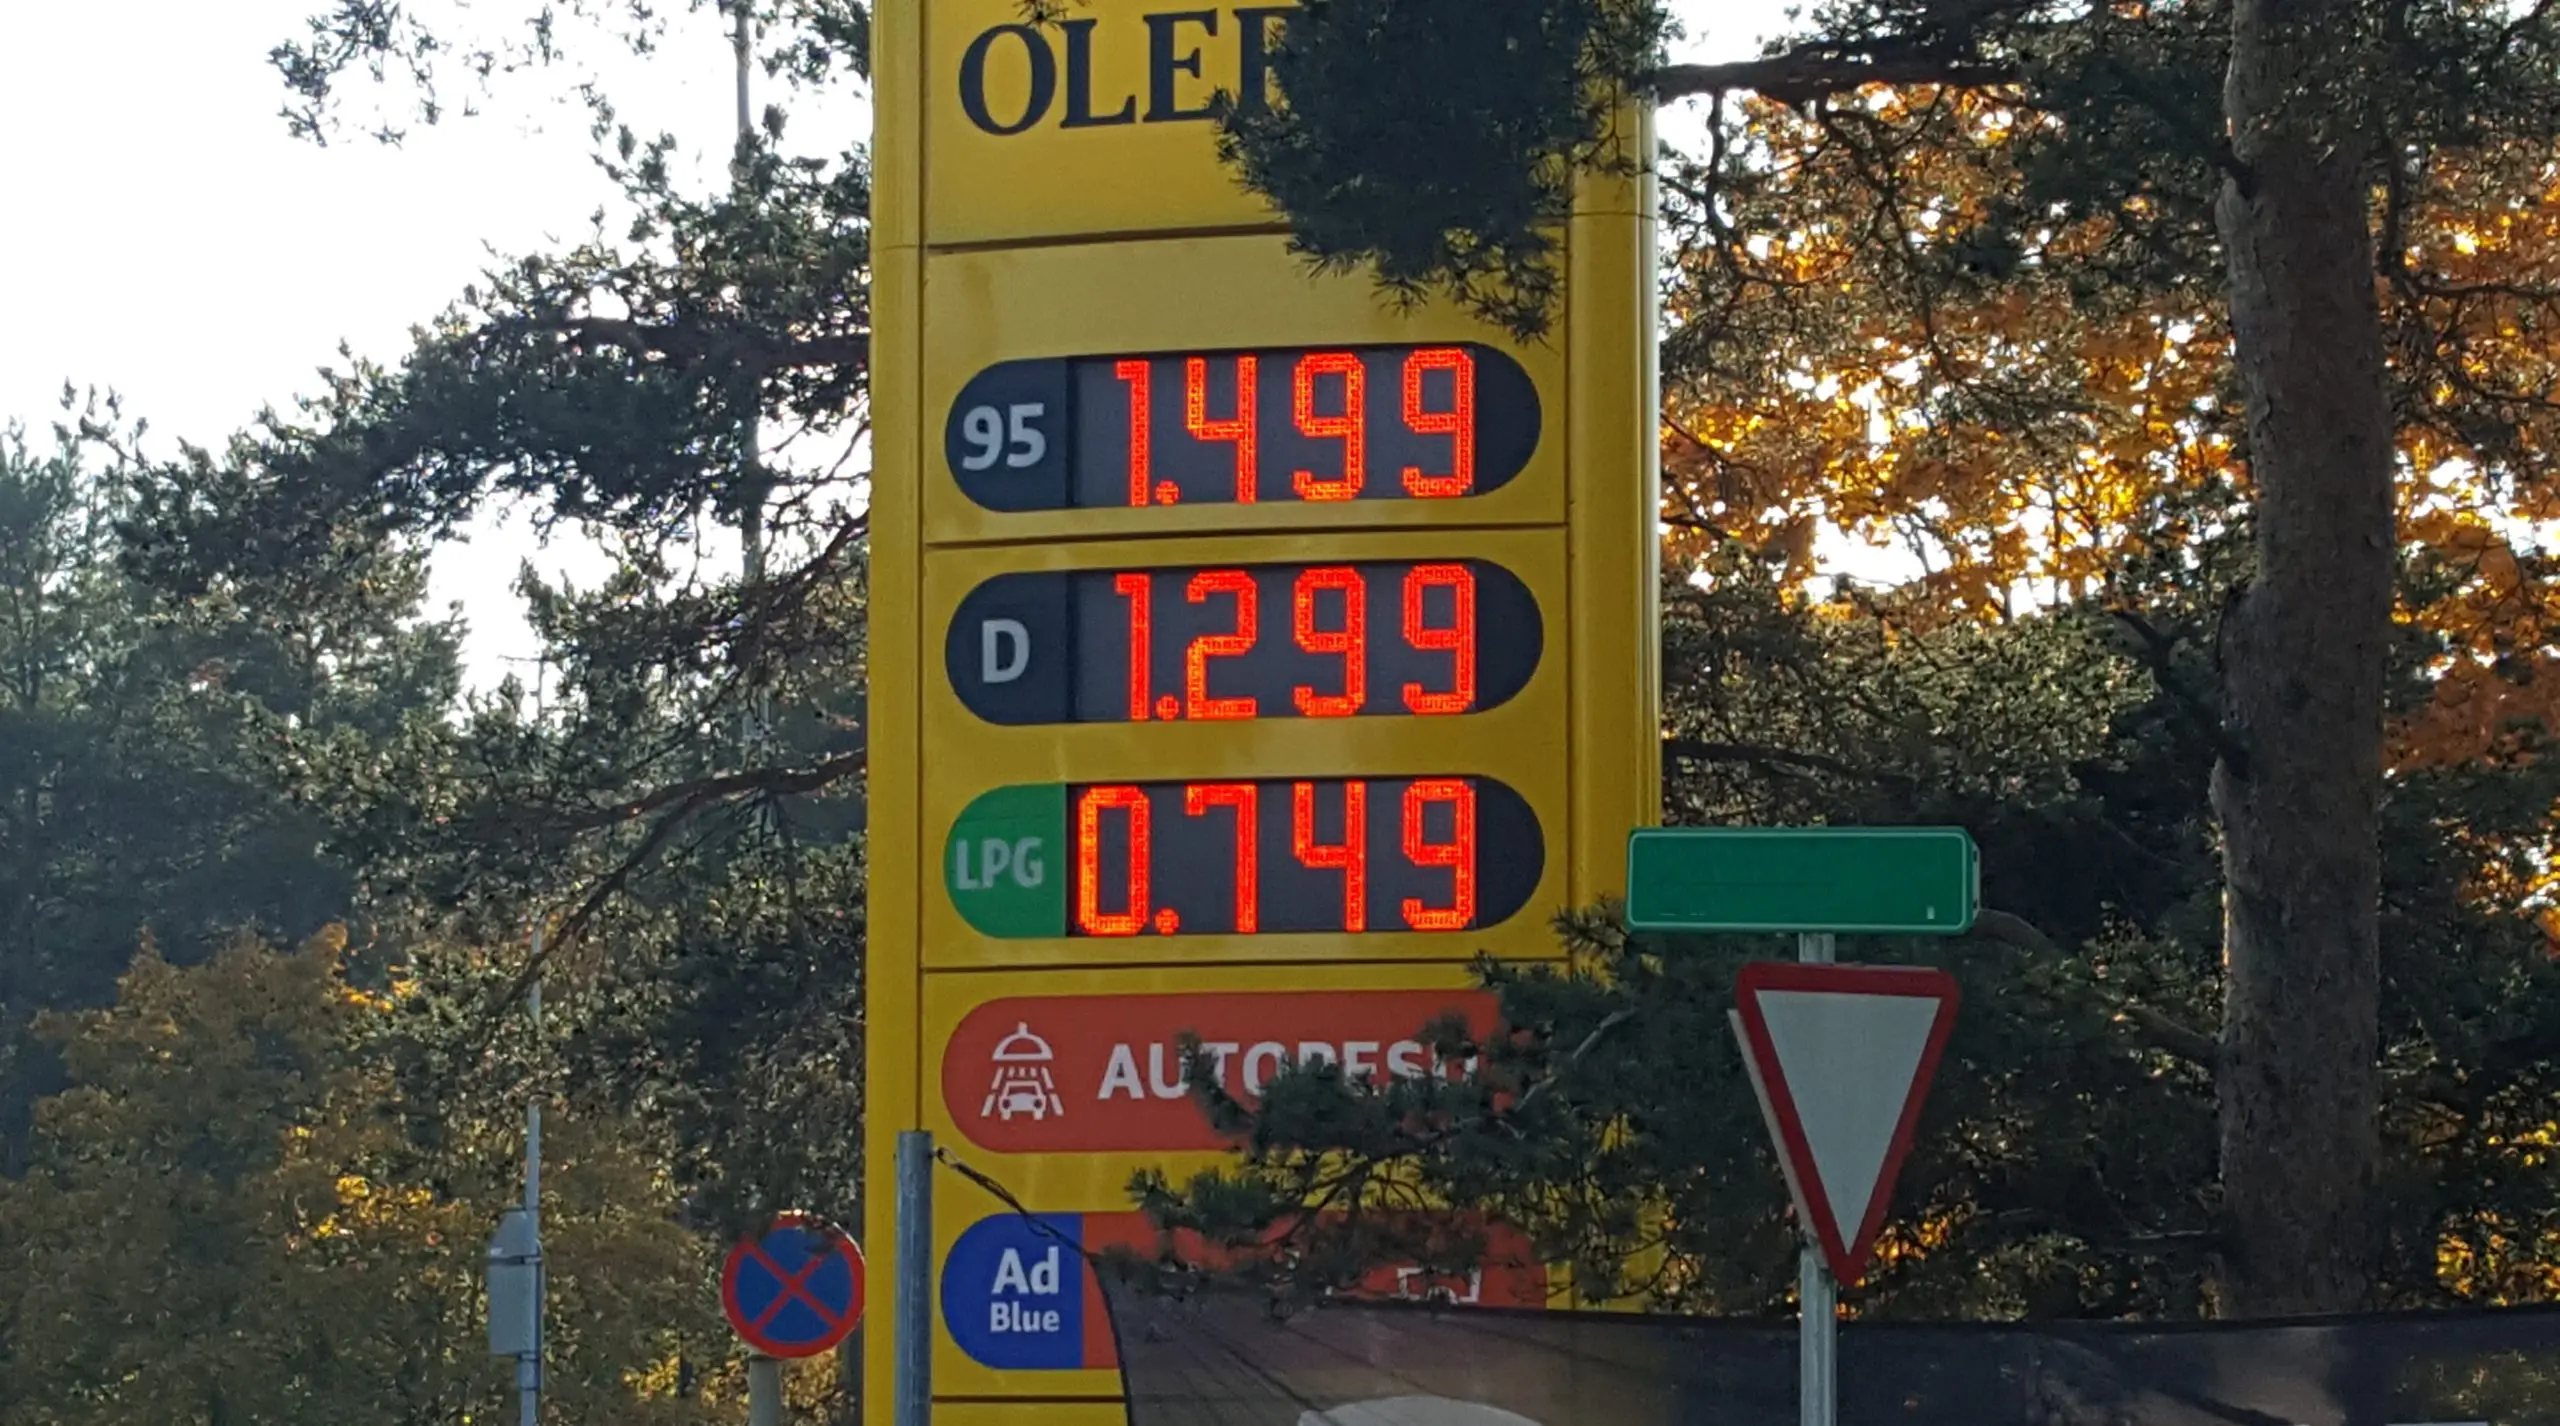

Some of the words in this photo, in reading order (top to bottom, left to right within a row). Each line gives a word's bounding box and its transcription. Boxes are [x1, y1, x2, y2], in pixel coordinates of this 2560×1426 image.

[962, 403, 1046, 470] 95
[1116, 348, 1475, 507] 1.499
[981, 619, 1030, 683] D
[1115, 563, 1475, 722] 1.299
[956, 836, 1043, 890] LPG
[1077, 778, 1476, 938] 0.749
[990, 1301, 1060, 1332] Blue
[991, 1246, 1060, 1294] Ad
